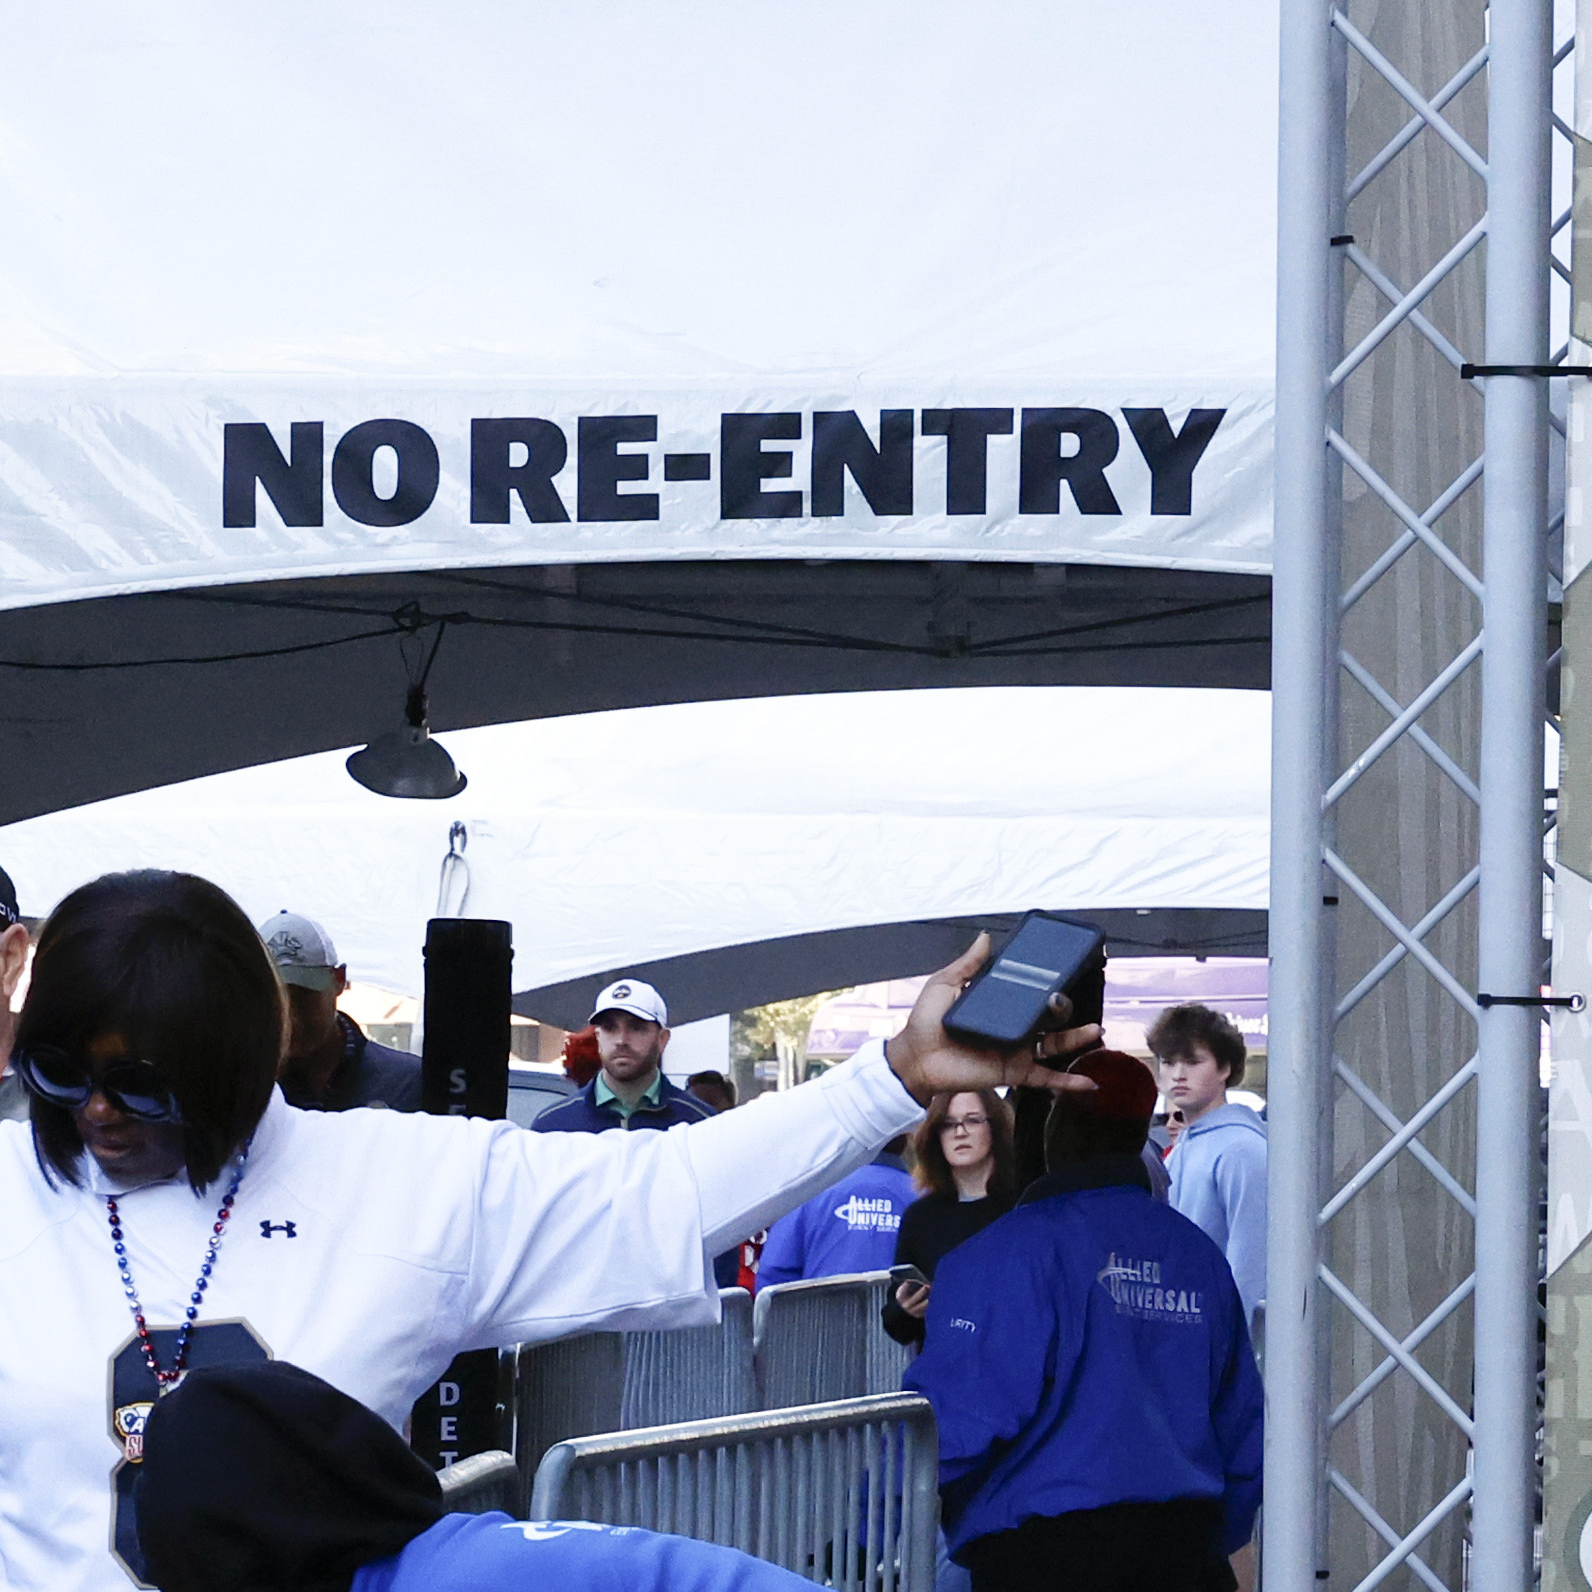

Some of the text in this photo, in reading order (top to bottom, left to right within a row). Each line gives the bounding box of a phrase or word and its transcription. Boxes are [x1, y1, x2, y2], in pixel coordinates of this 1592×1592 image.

[222, 407, 1226, 528] NO RE-ENTRY
[848, 1195, 892, 1213] ALLIED
[848, 1206, 901, 1229] UNIVERS
[1110, 1275, 1201, 1313] UNIVERSAL
